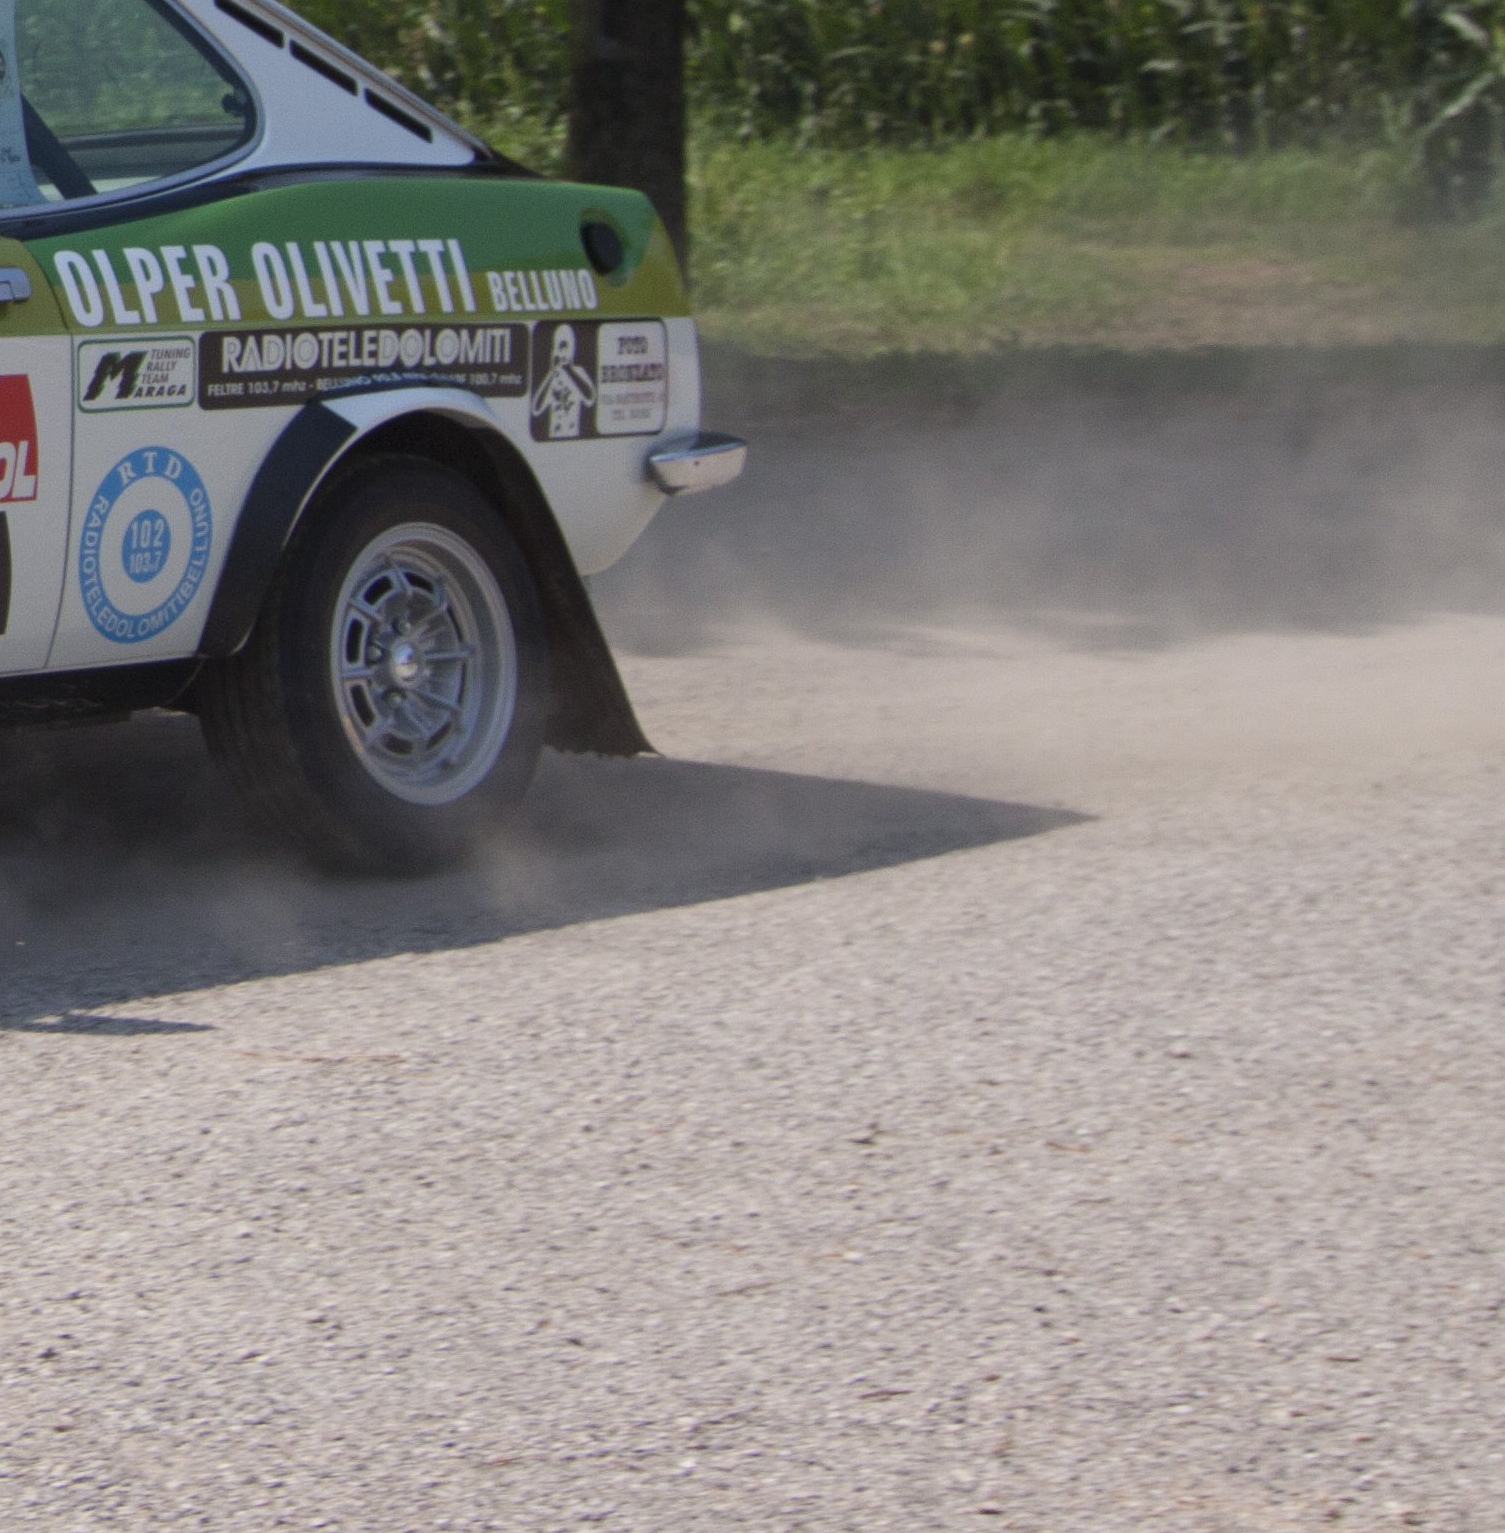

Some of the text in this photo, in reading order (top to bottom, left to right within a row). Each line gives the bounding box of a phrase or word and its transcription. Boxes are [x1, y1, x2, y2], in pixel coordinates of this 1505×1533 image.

[53, 239, 598, 327] OLPER OLIVETTI BELLUNO
[150, 348, 190, 359] TUNING
[222, 328, 511, 372] RADIOTELEDOLOMITI
[146, 360, 178, 372] RALLY
[141, 373, 169, 384] TEAM
[208, 383, 244, 397] FELTRE
[131, 518, 165, 550] 102
